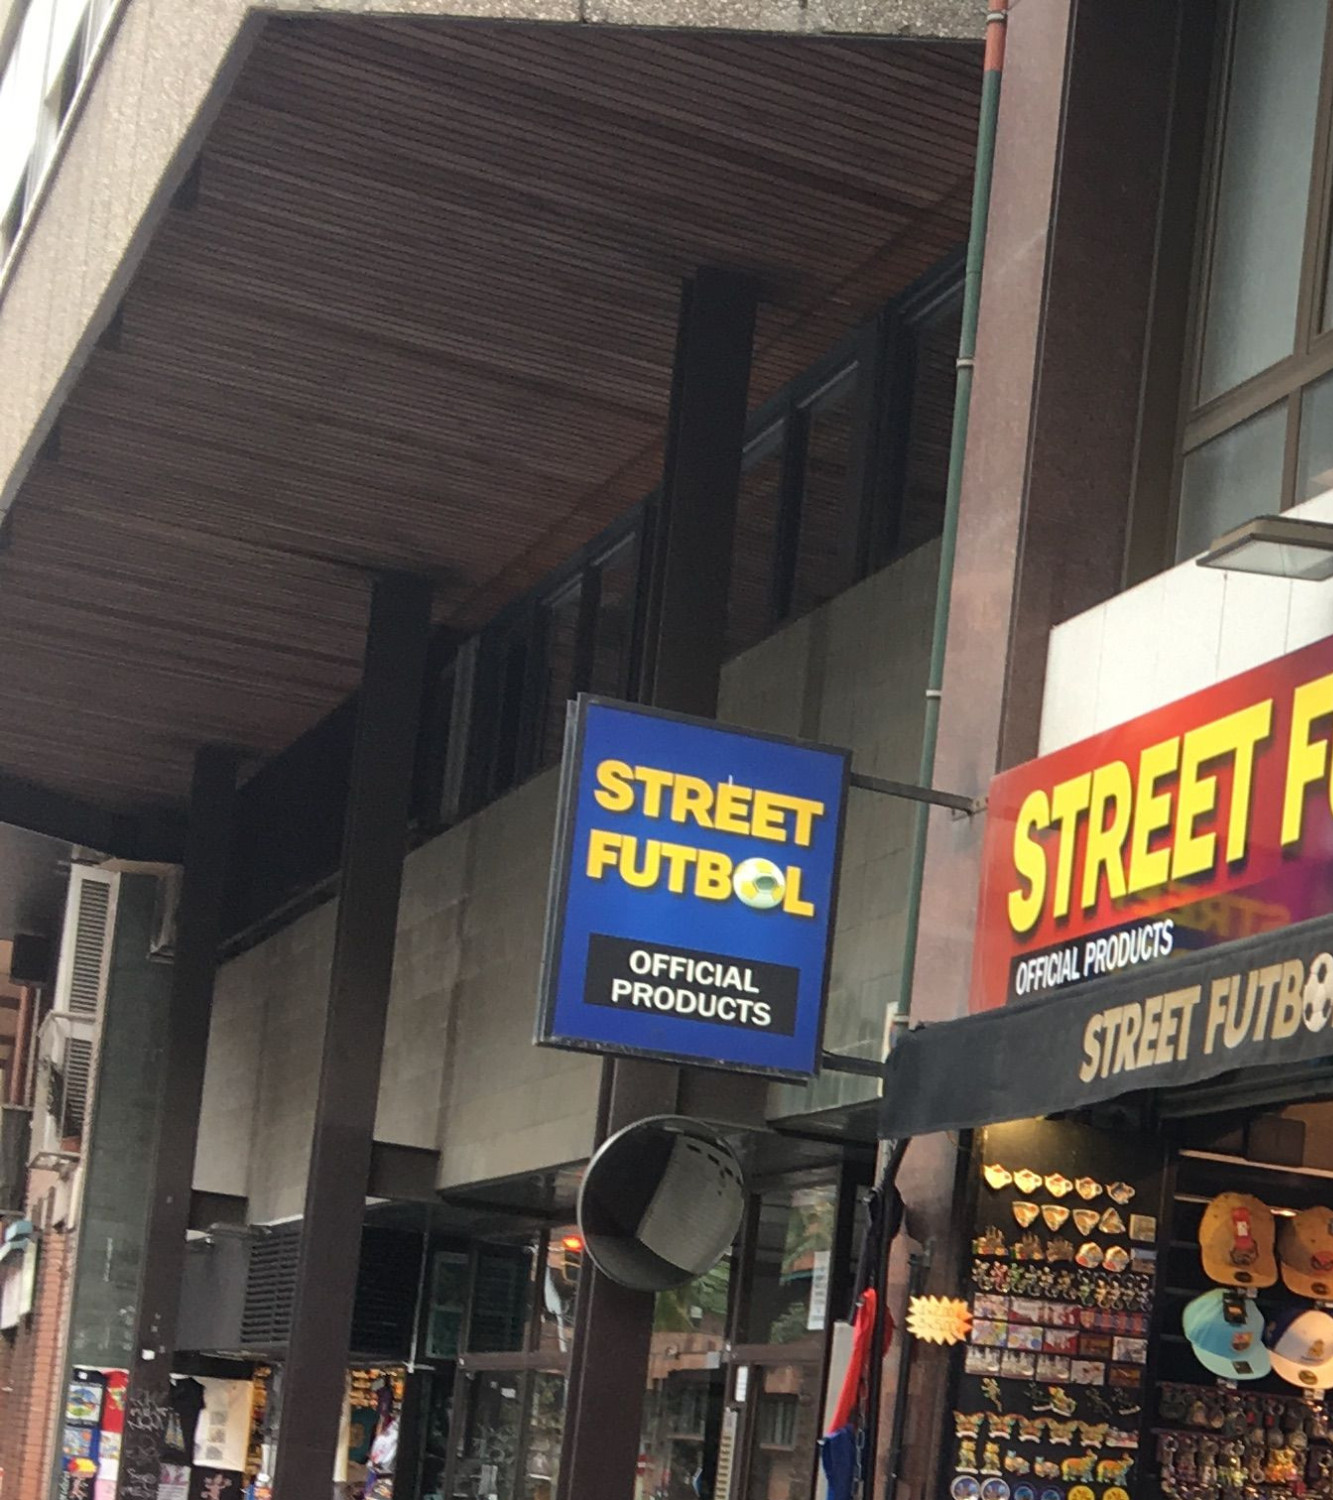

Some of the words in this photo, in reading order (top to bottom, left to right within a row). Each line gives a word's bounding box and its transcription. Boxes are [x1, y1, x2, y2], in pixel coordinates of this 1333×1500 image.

[593, 759, 824, 846] STREET
[1008, 699, 1273, 932] STREET
[586, 828, 815, 918] FUTBOL
[629, 949, 760, 994] OFFICIAL
[1015, 946, 1081, 995] OFFICIAL
[1083, 918, 1175, 977] PRODUCTS
[611, 978, 772, 1027] PRODUCTS
[1079, 984, 1202, 1083] STREET
